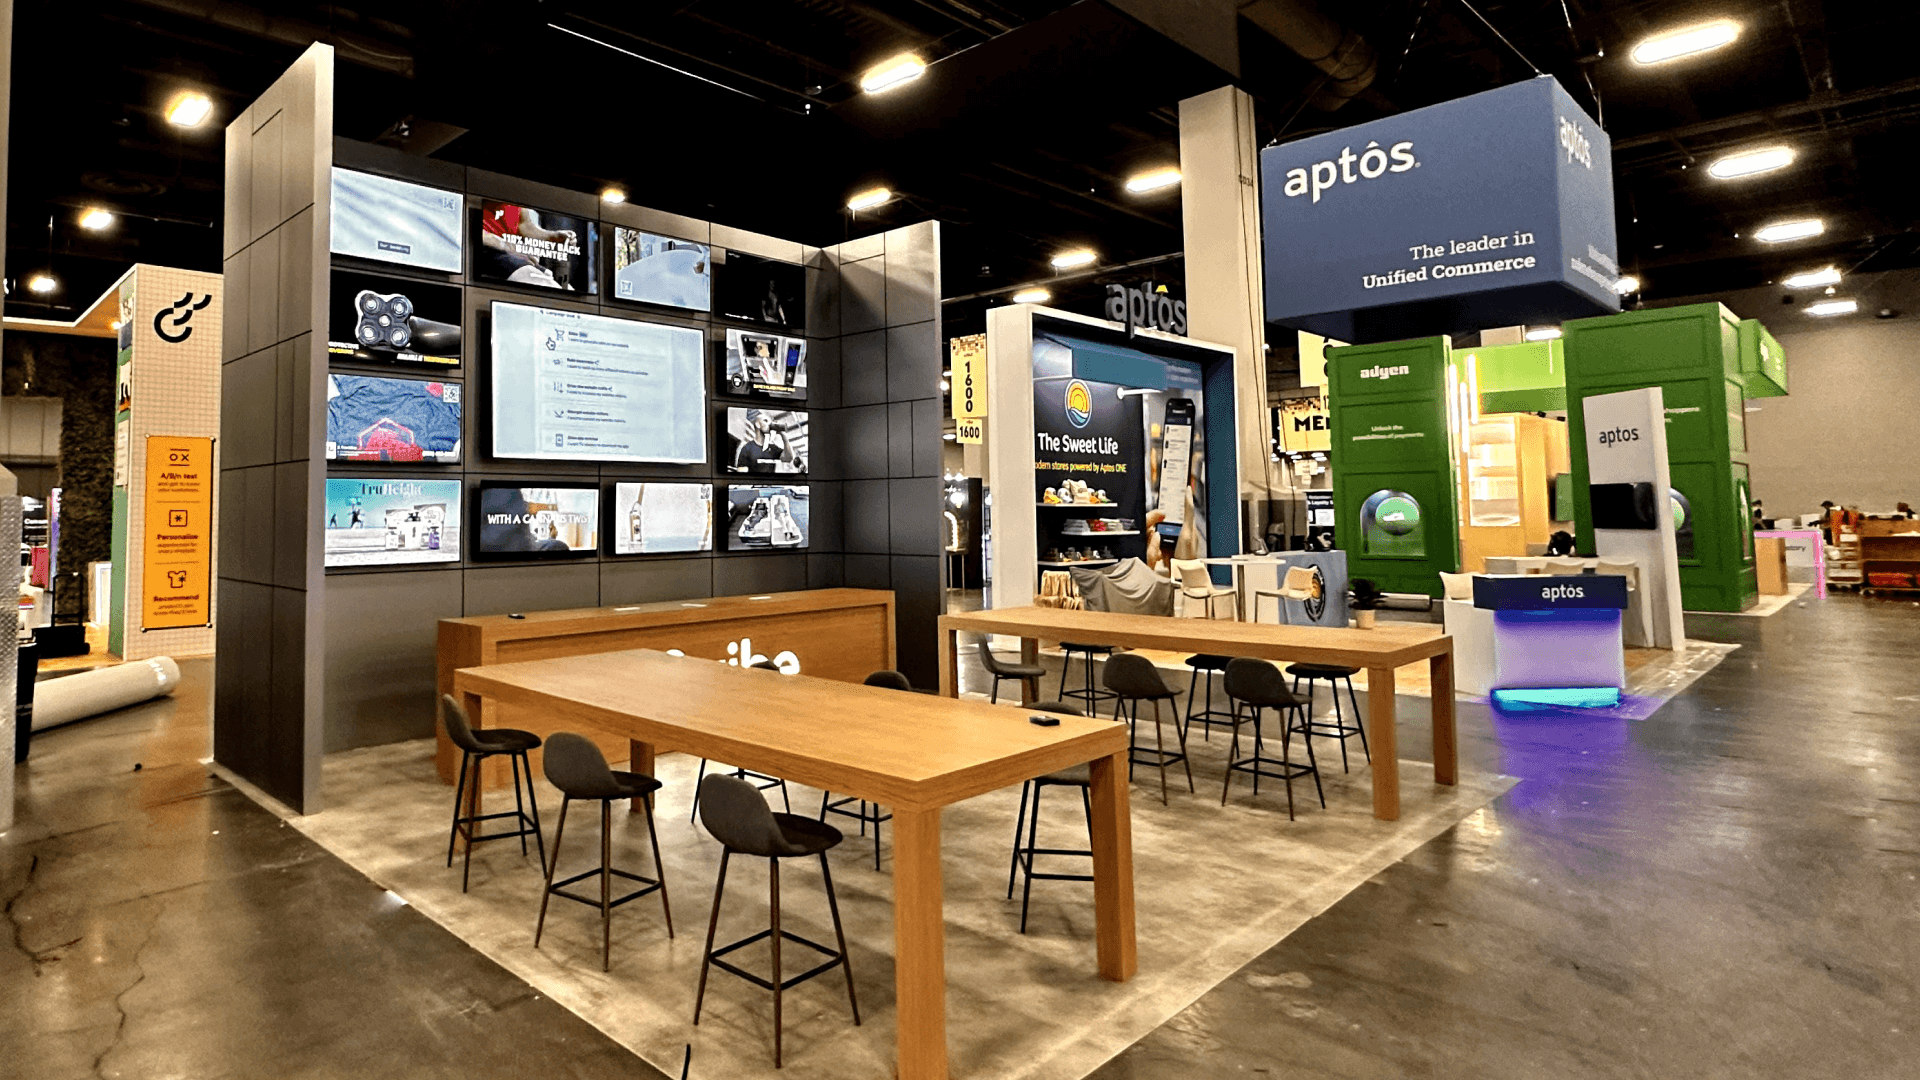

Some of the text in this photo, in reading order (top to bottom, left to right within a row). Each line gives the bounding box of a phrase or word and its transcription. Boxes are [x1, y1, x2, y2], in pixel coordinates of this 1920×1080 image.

[502, 232, 580, 256] 110% MONEY BACK
[515, 244, 569, 261] GUARANTEE
[1409, 230, 1536, 260] The leader in
[1362, 255, 1536, 289] Unified Commerce
[1360, 365, 1409, 379] adyen
[964, 361, 973, 413] 1600
[959, 426, 979, 439] 1600
[1037, 432, 1119, 455] The Sweet Life
[1035, 460, 1051, 470] odern
[1070, 462, 1092, 473] powered
[1093, 462, 1099, 474] by
[487, 513, 512, 525] WITH
[512, 514, 521, 525] A
[153, 594, 199, 602] Recommend
